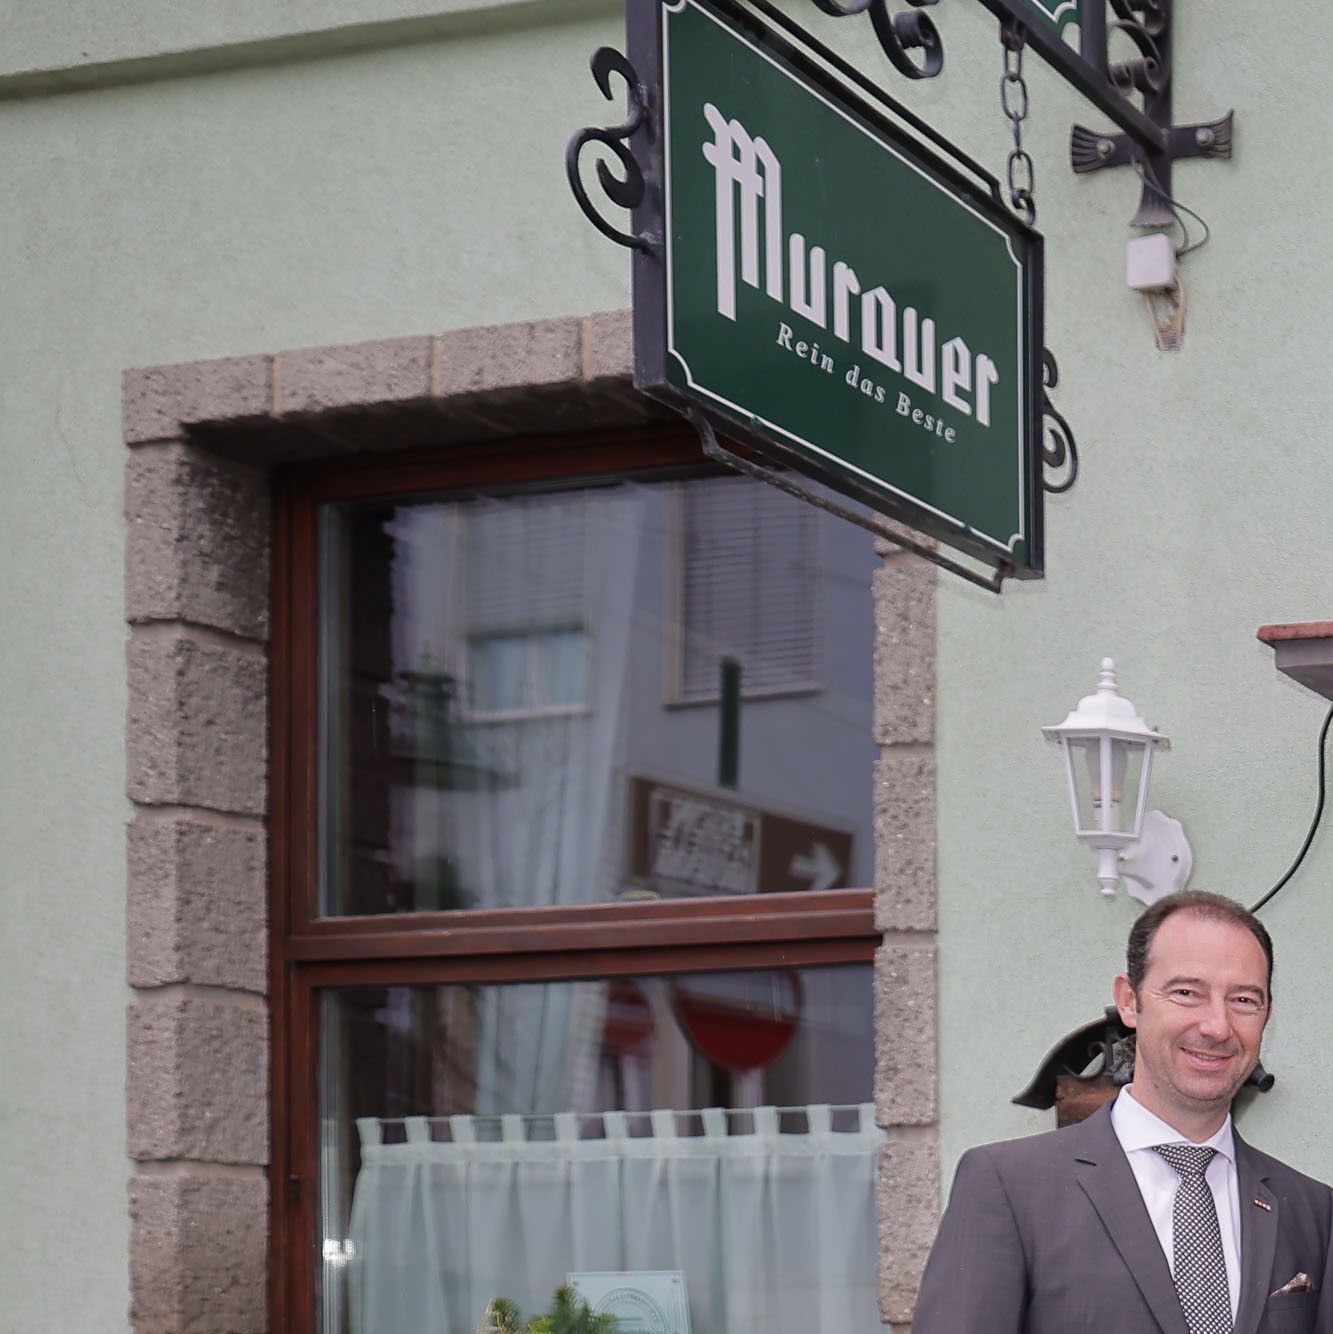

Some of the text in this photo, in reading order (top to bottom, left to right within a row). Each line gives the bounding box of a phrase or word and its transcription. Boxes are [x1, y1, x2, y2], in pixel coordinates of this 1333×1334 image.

[702, 102, 999, 427] Murauer
[776, 322, 957, 443] Rein das Beste
